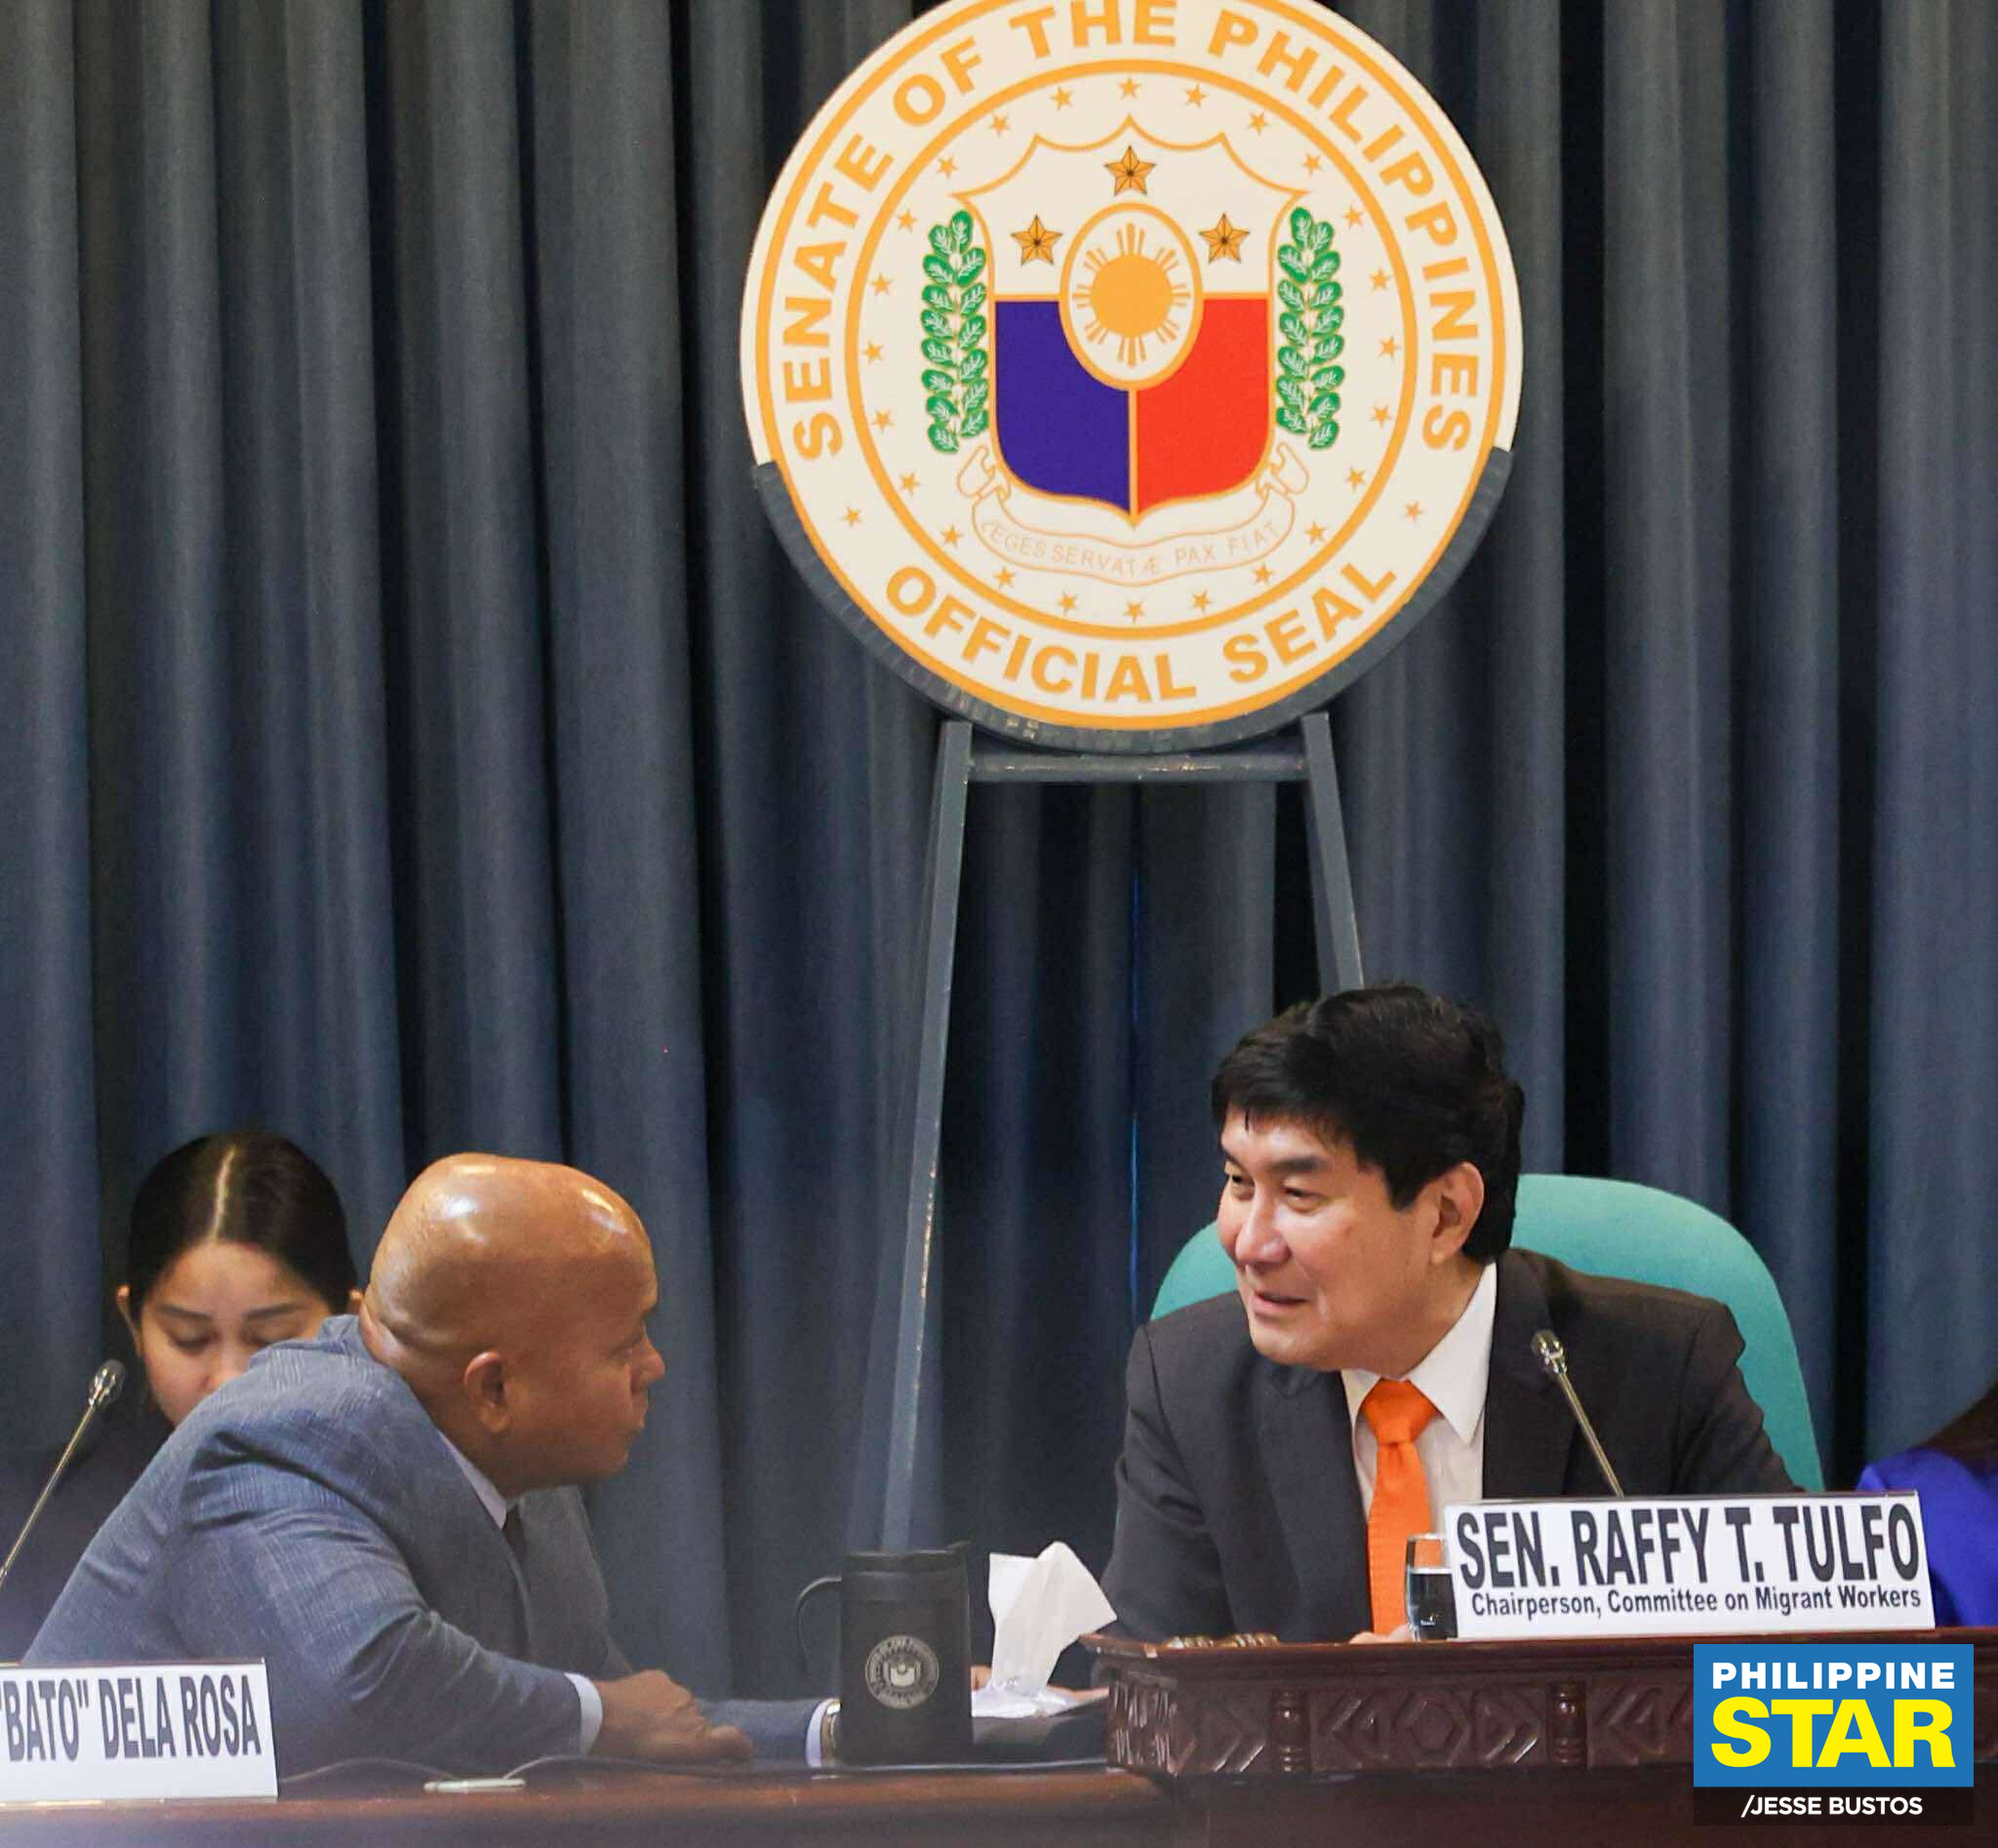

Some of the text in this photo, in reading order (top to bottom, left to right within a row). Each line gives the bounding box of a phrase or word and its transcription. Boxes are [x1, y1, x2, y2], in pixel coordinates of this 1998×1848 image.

[780, 0, 1481, 462] SENATE OF THE PHILIPPINES
[1174, 545, 1217, 564] PAX
[1225, 520, 1281, 557] FIAT
[884, 561, 1397, 703] OFFICIAL SEAL
[1457, 1503, 1920, 1590] SEN. RAFFY T. TULFO
[1471, 1584, 1921, 1622] Chairperson, Committee on Migrant Workers
[98, 1676, 178, 1759] DELA
[179, 1673, 262, 1757] ROSA
